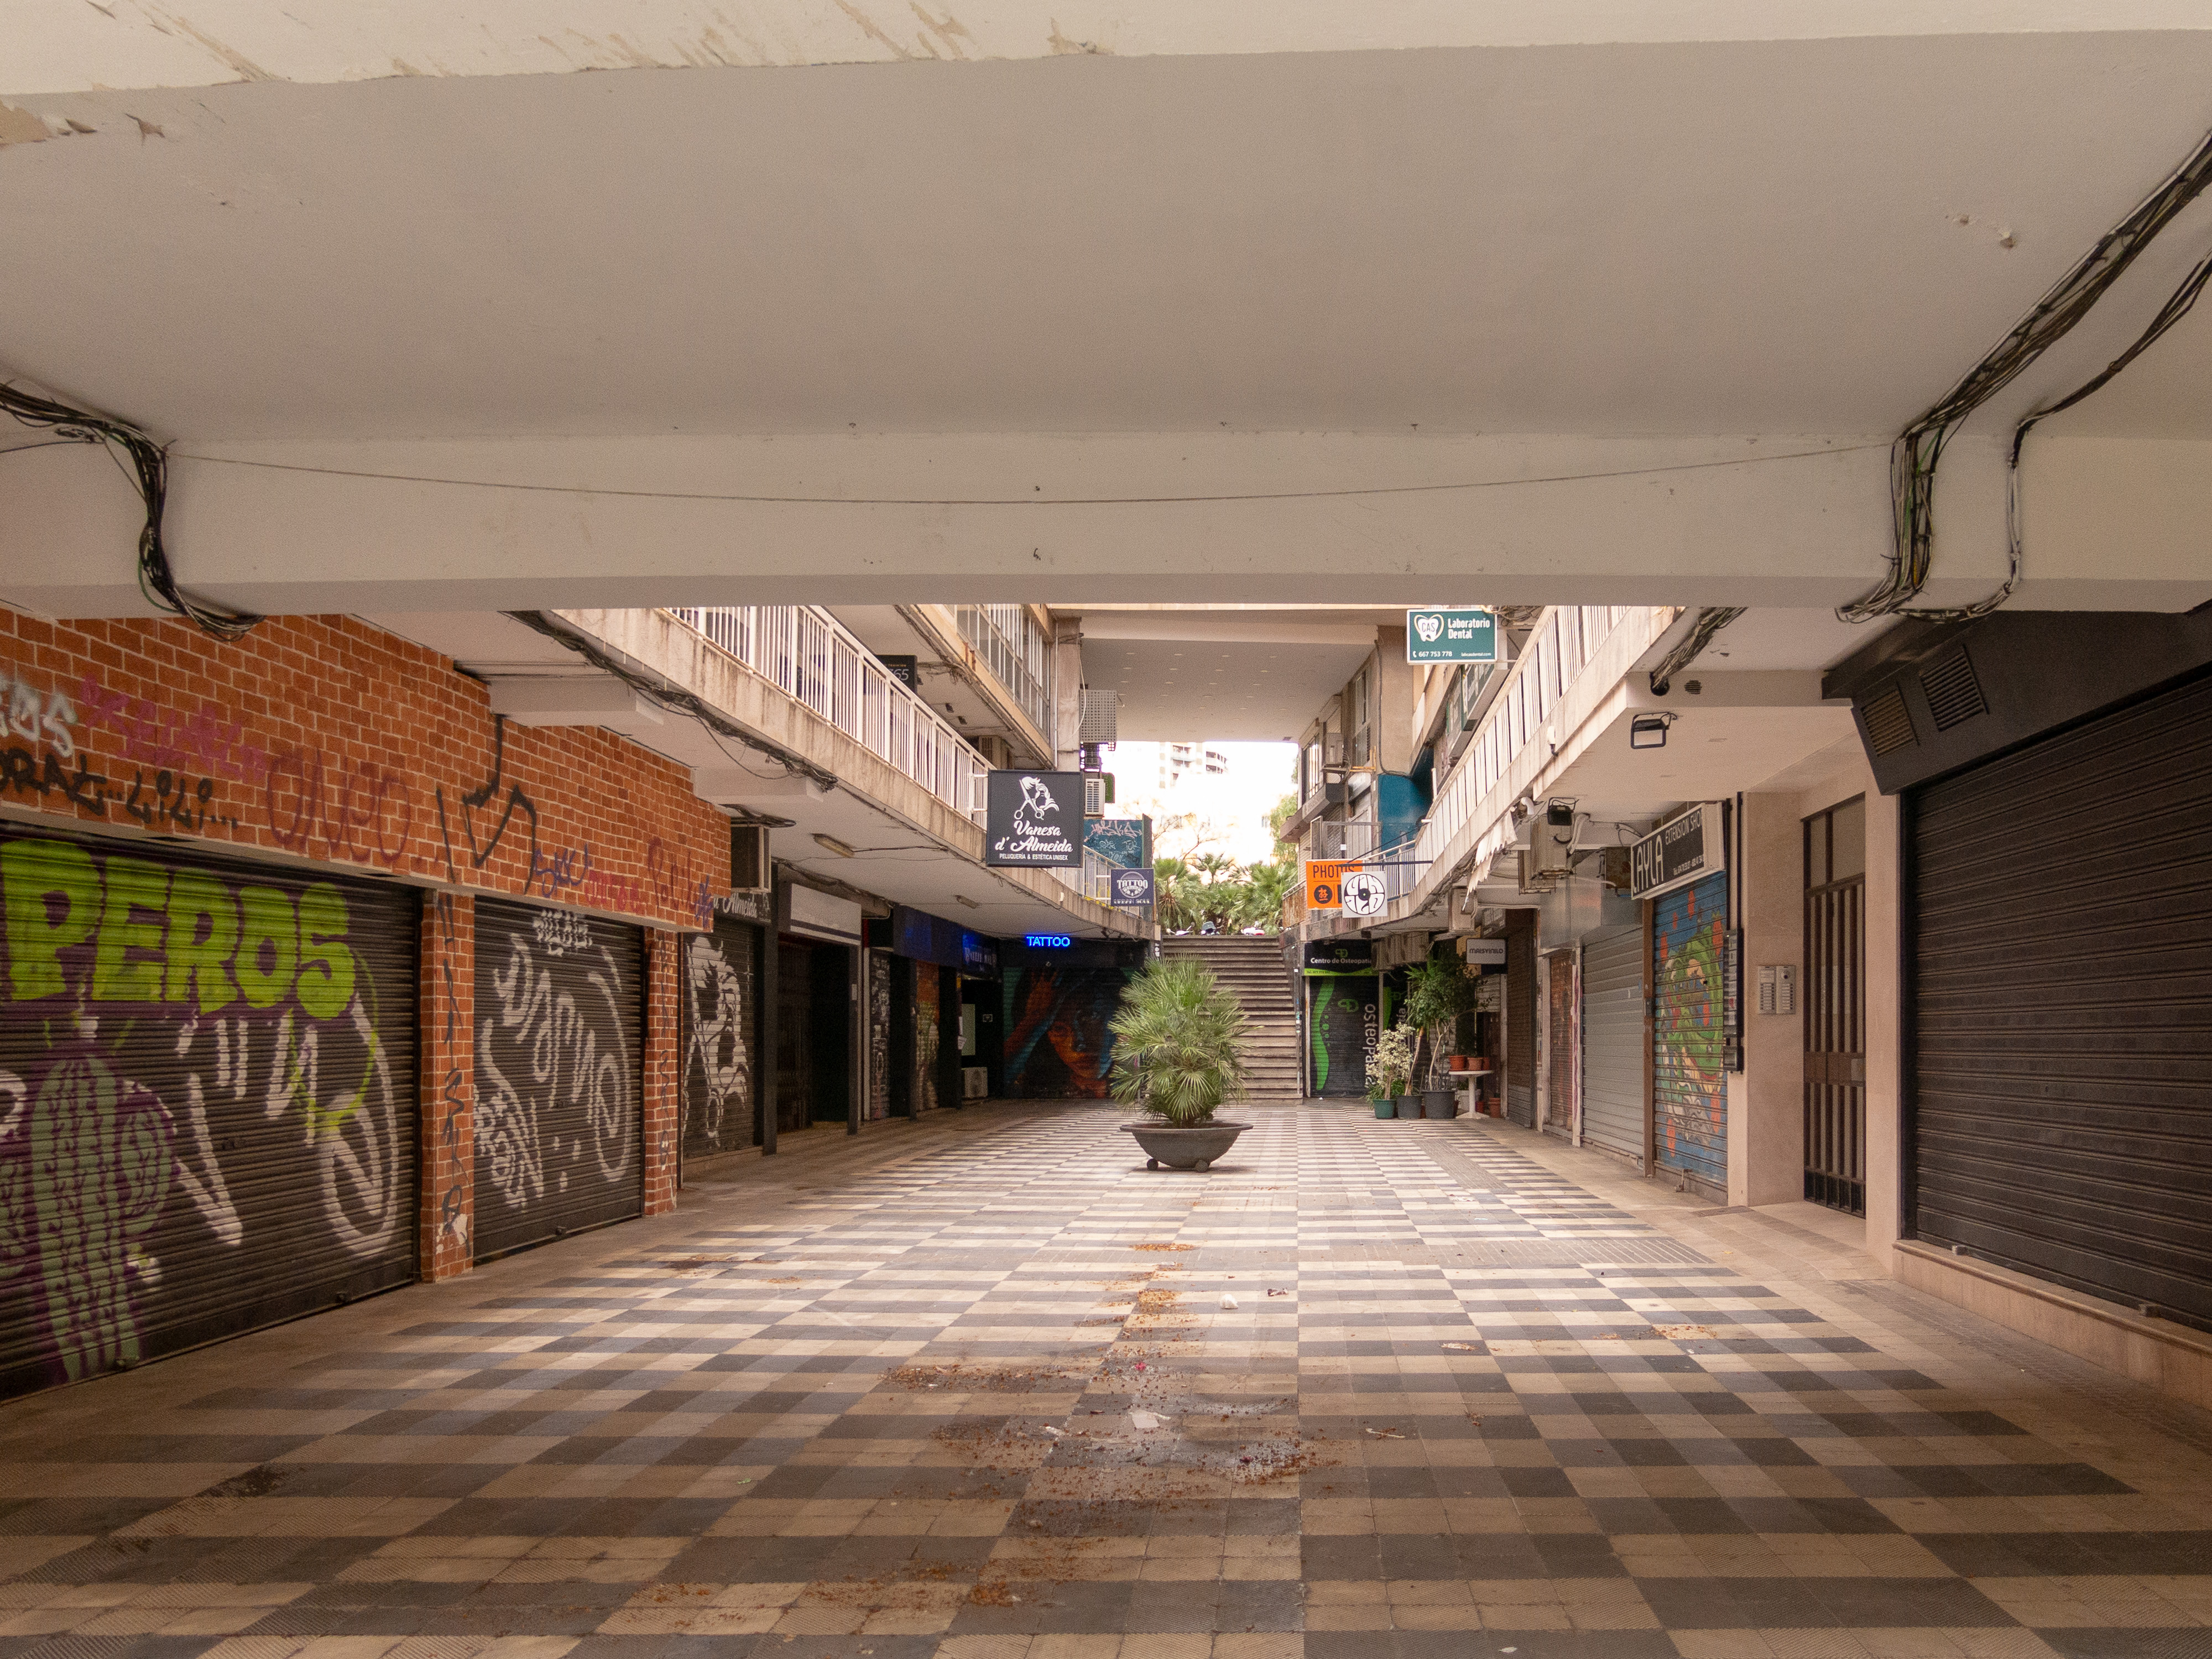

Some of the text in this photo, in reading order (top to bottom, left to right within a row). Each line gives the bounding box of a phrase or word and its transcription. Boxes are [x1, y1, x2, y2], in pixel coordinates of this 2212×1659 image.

[1422, 622, 1435, 633] CAS
[1448, 618, 1490, 629] Laboratorio
[1448, 629, 1473, 639] Dental
[1690, 810, 1702, 832] SHO
[1013, 820, 1062, 836] Vanesa
[1010, 835, 1073, 852] Almeida
[1631, 834, 1664, 894] LAYLA
[1117, 879, 1149, 889] TATTOO
[1026, 936, 1071, 947] TATTOO
